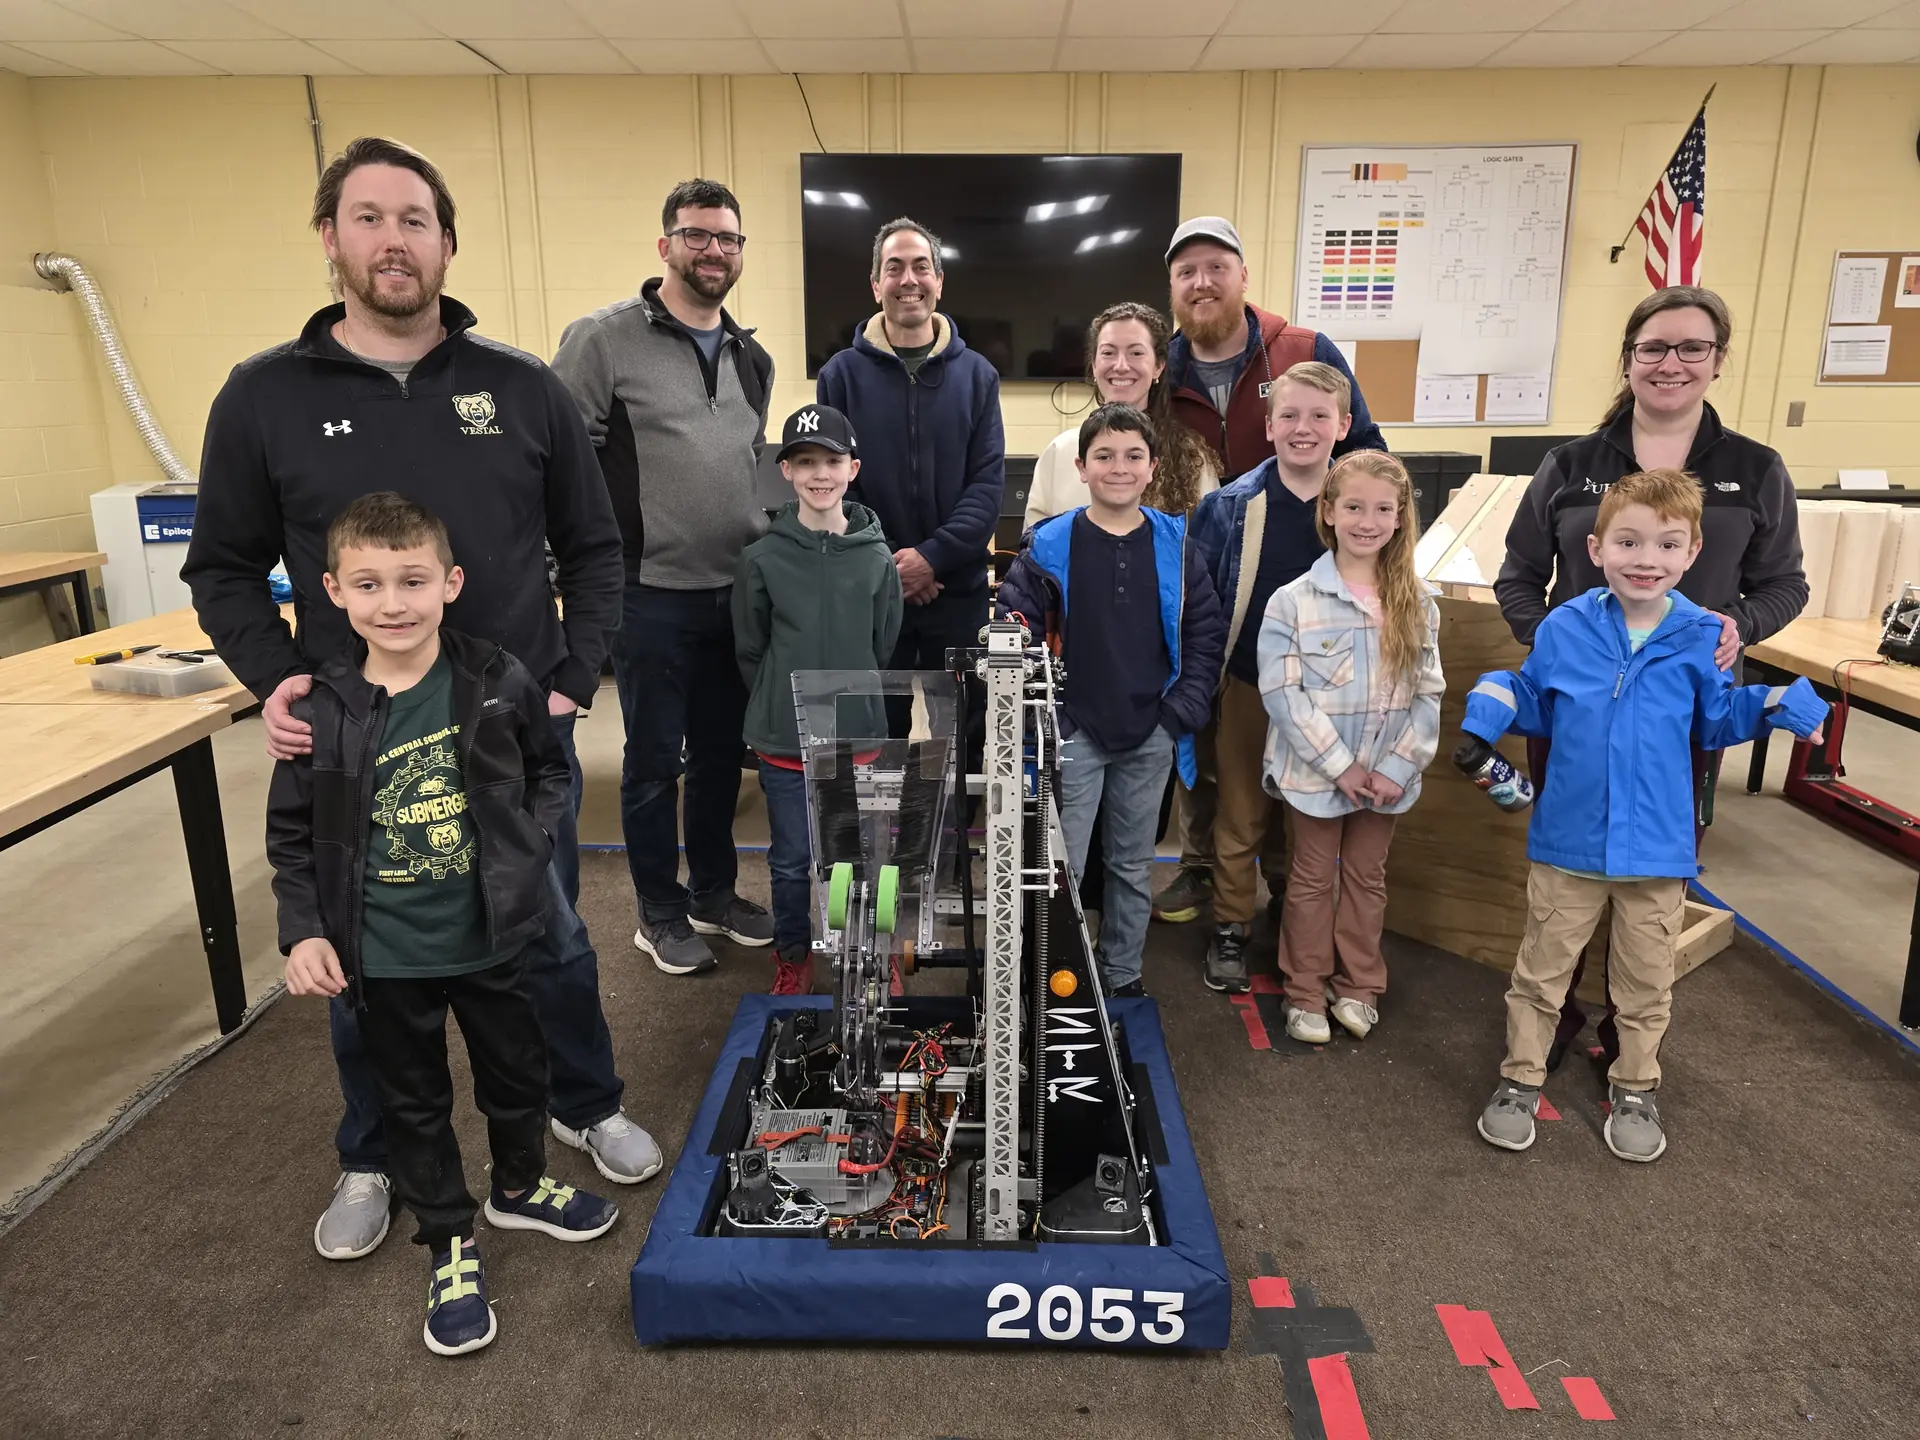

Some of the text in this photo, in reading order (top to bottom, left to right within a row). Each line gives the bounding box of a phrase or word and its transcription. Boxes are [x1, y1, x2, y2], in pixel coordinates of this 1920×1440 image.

[460, 425, 503, 435] VESTAL
[796, 410, 820, 433] NY
[162, 527, 193, 537] Epilog
[388, 738, 424, 758] CENTRAL
[423, 727, 452, 745] SCHOOL
[986, 1282, 1185, 1344] 2053
